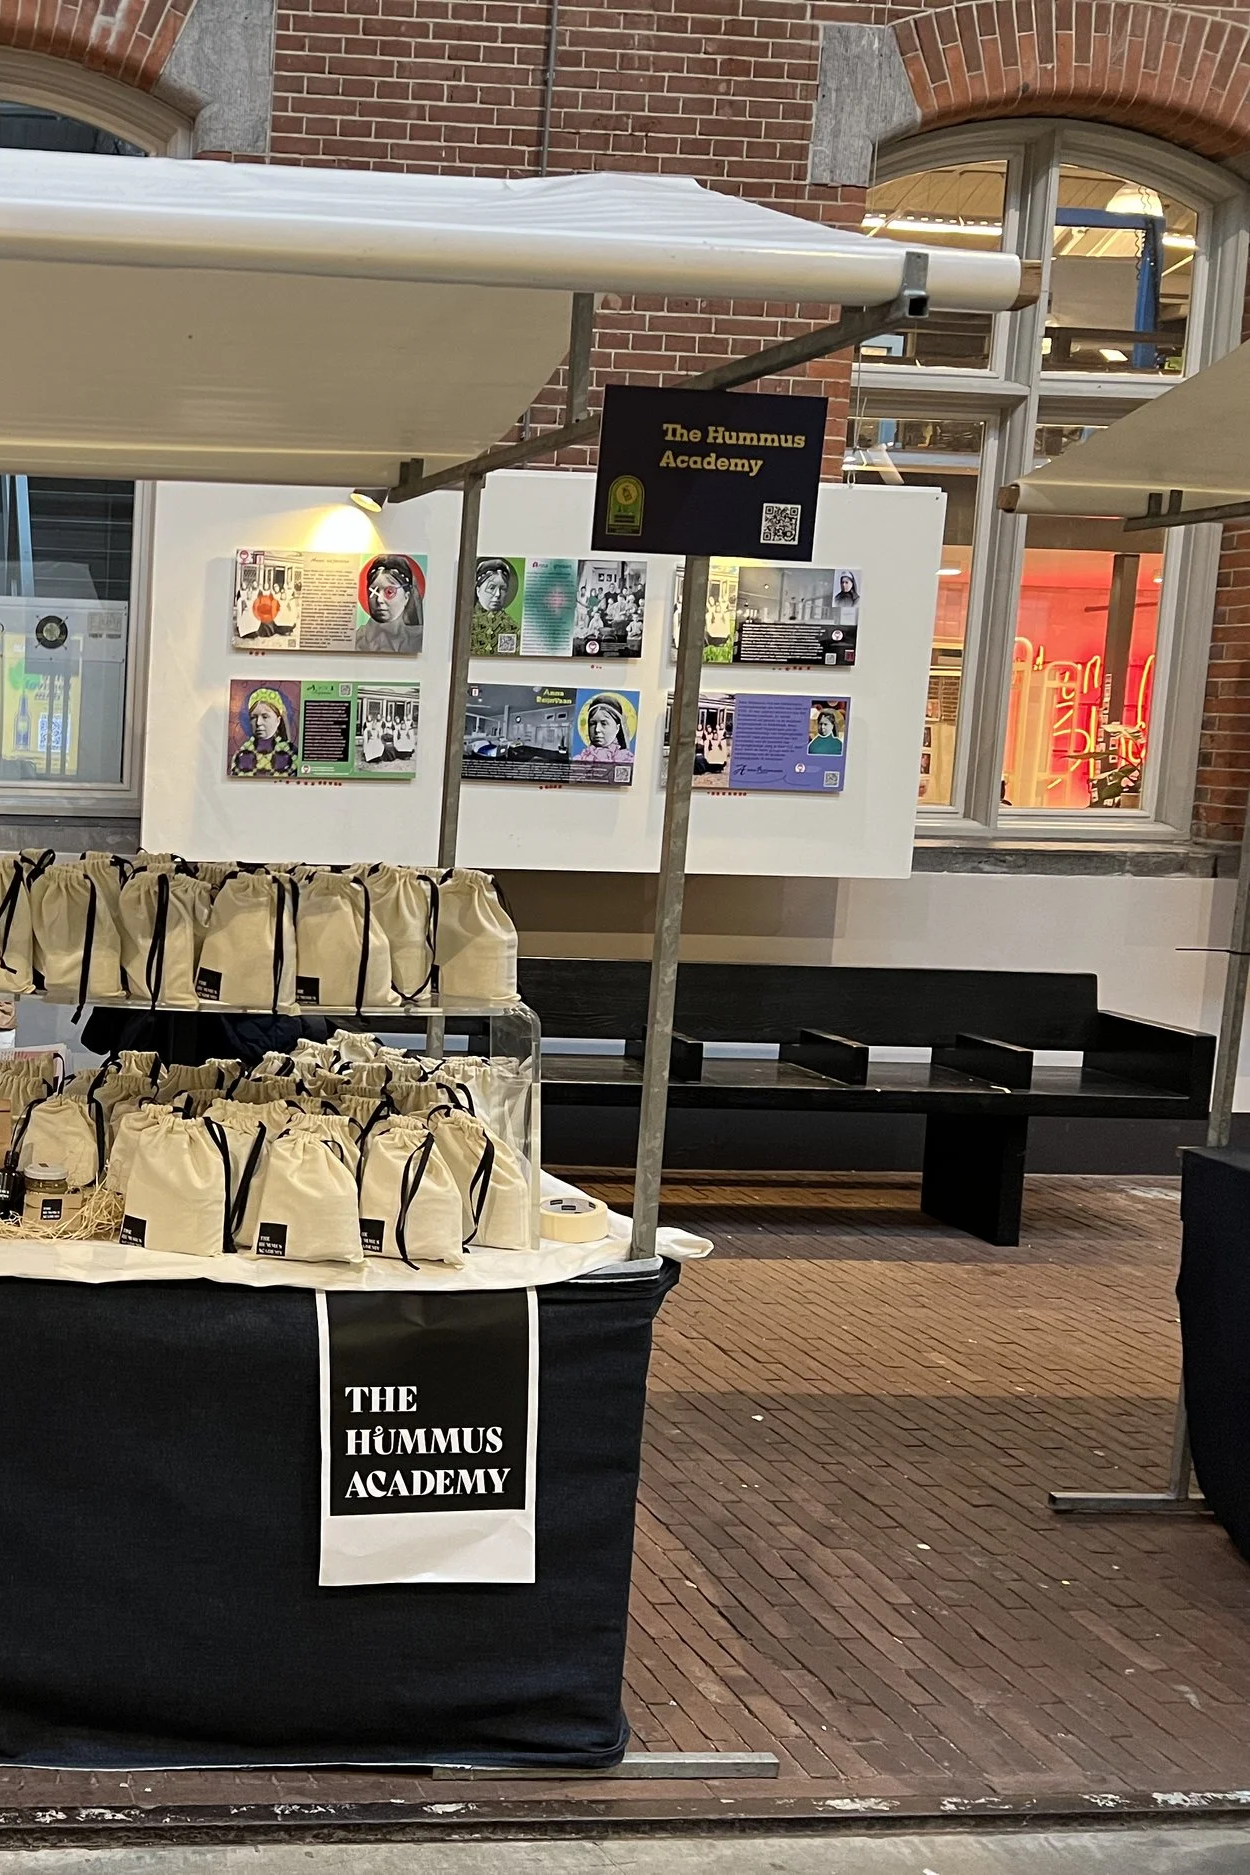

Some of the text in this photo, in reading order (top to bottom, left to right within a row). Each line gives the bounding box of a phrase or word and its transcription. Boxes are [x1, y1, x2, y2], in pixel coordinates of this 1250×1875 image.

[662, 423, 806, 449] The Hummus
[659, 450, 764, 477] Academy
[344, 1385, 418, 1413] THE
[344, 1425, 503, 1455] HUMMUS
[344, 1467, 511, 1499] ACADEMY
